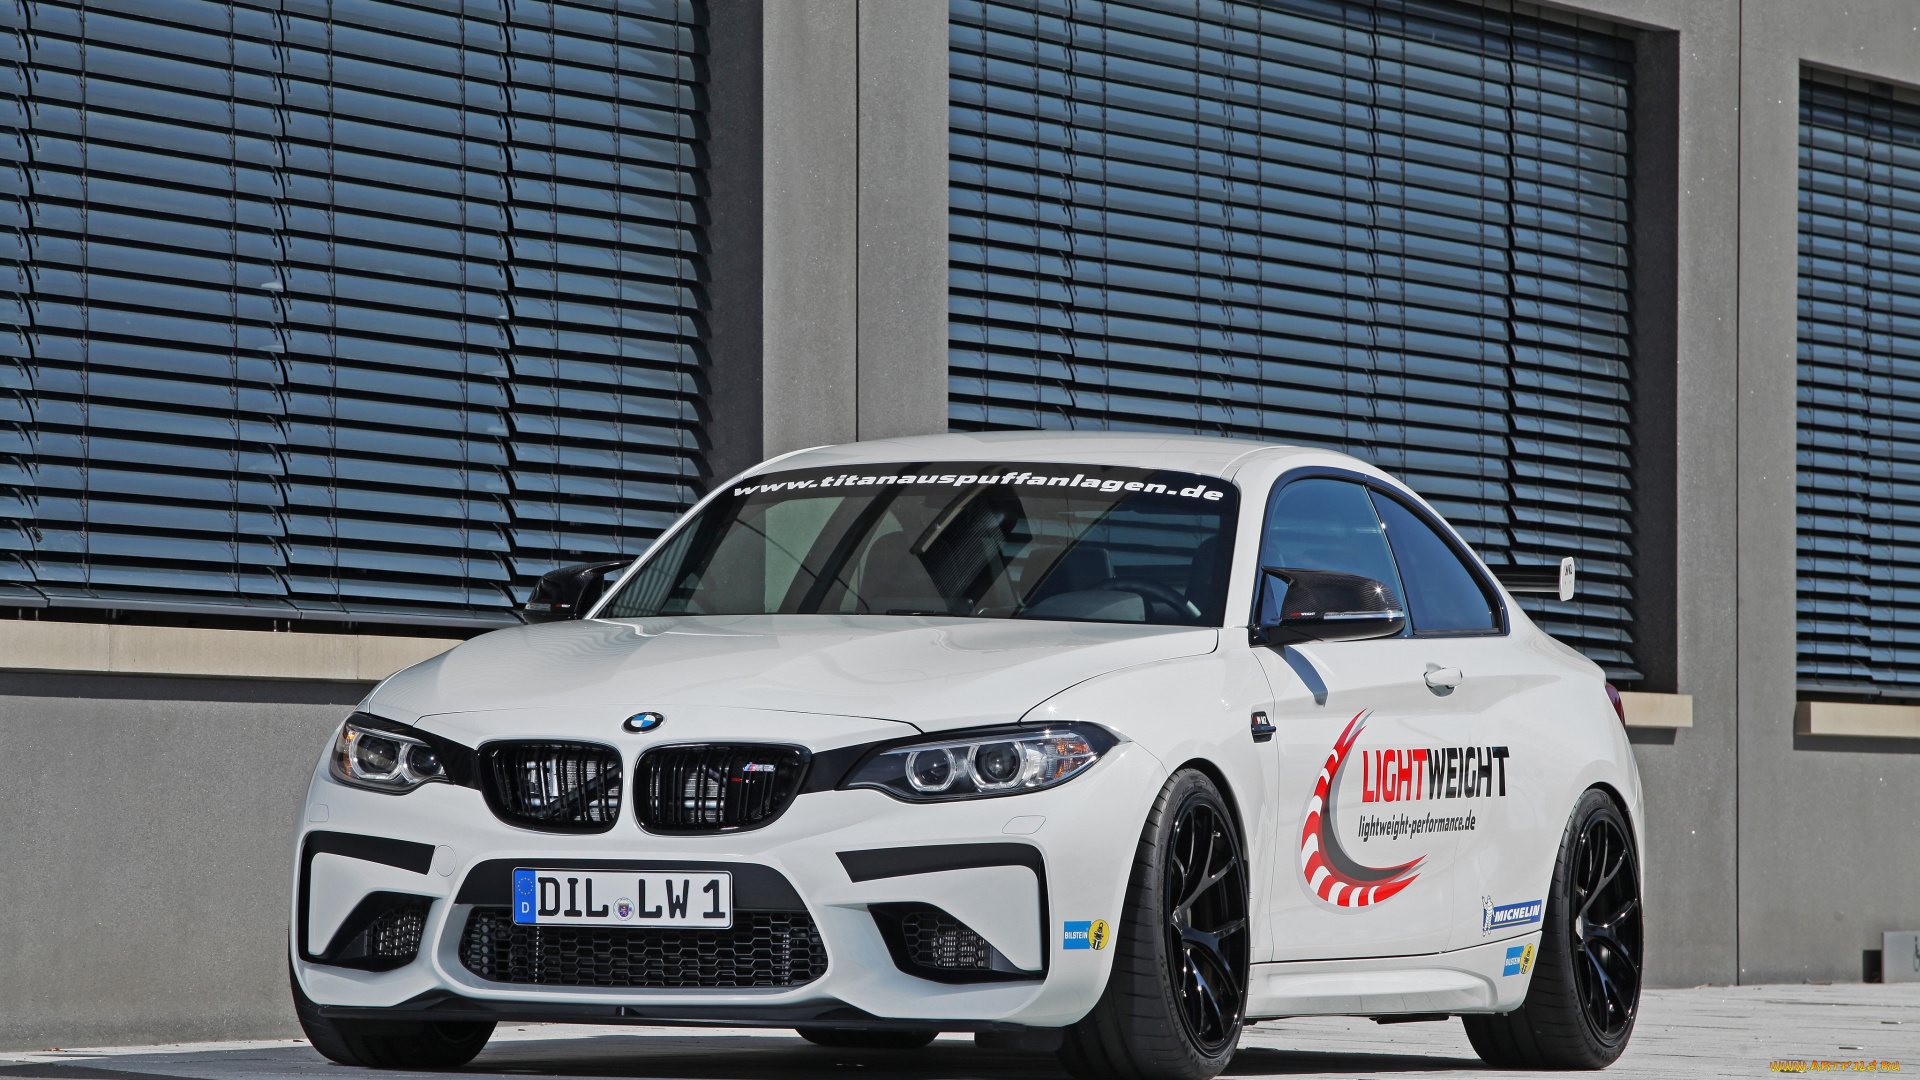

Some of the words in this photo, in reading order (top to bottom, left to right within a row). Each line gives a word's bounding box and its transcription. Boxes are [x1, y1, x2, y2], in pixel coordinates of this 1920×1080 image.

[733, 471, 1224, 502] www.titanauspuffanlagen.de
[1362, 746, 1510, 803] LIGHTWEIGHT
[1358, 809, 1476, 842] lightweight-performance.de
[521, 902, 530, 914] D
[537, 877, 609, 918] DIL
[638, 879, 690, 919] LW
[703, 879, 726, 919] 1
[1494, 904, 1541, 923] MICHELIN
[1064, 931, 1089, 940] BILSTEIN
